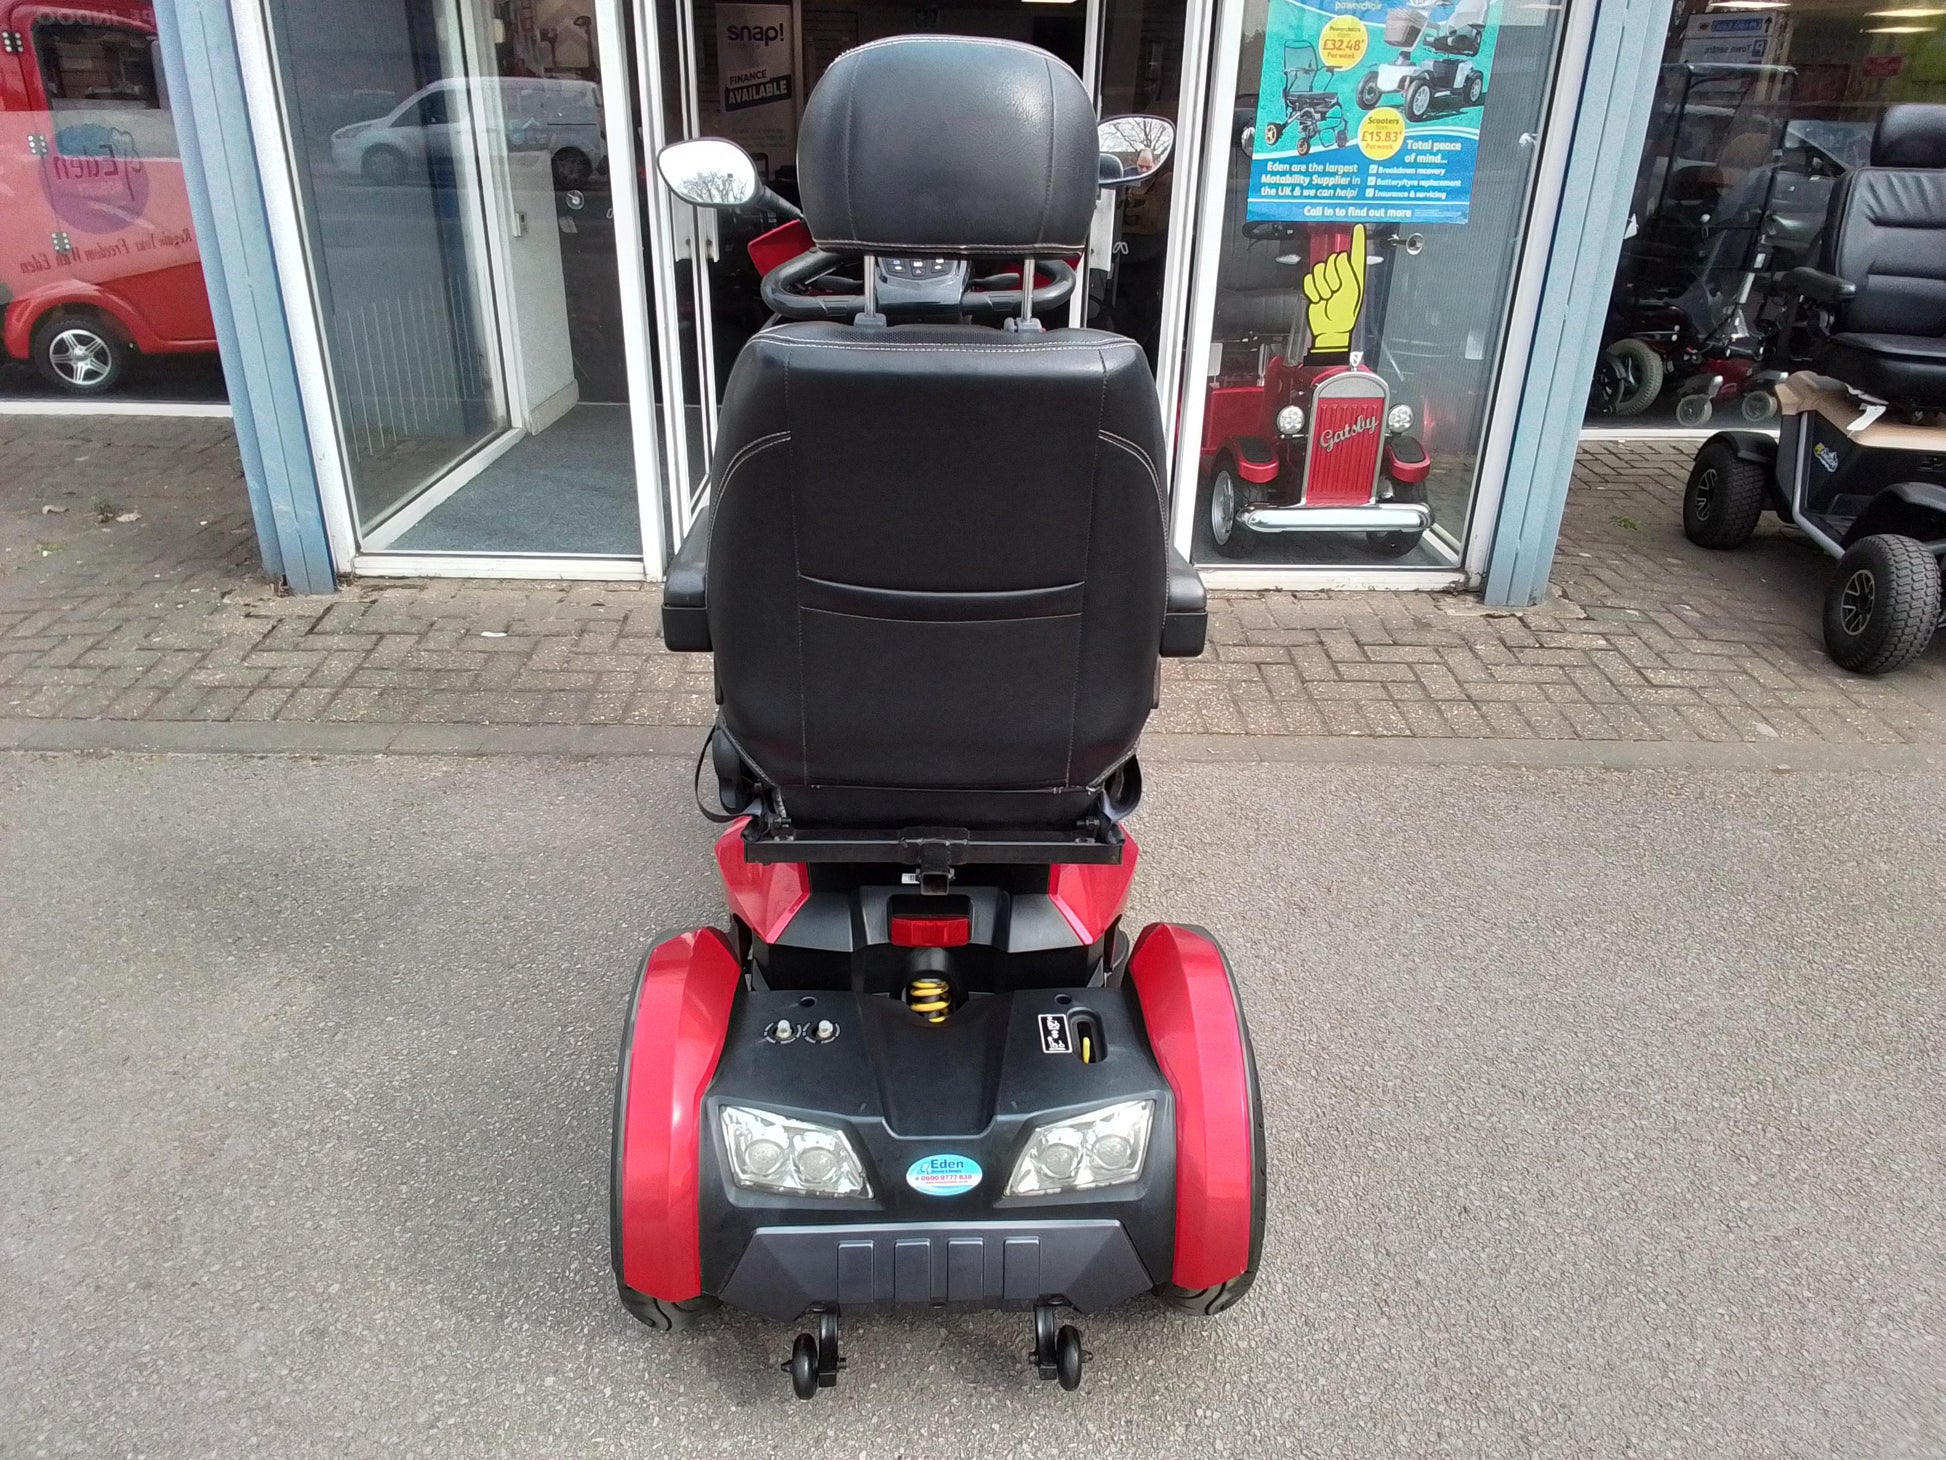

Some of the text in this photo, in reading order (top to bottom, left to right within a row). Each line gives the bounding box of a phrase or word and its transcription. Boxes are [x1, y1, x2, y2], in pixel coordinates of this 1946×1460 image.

[727, 23, 784, 46] snap!
[729, 69, 767, 86] FINANCE
[728, 80, 787, 104] AVAILABLE
[1367, 116, 1399, 125] Scooters
[1406, 139, 1462, 152] Total peace
[1404, 152, 1416, 163] of
[1267, 161, 1358, 174] Eden are the largest
[1378, 166, 1446, 176] Breakdown recovery
[1261, 174, 1311, 186] Motability
[1312, 175, 1351, 187] Supplier
[1419, 179, 1462, 188] replacement
[1261, 186, 1359, 199] the UK & we can help!
[1374, 190, 1408, 198] Insurance
[1415, 191, 1447, 200] servicing
[1304, 205, 1323, 216] Call
[1324, 208, 1334, 216] in
[1335, 208, 1346, 217] to
[1348, 207, 1367, 217] find
[1368, 208, 1386, 218] out
[1387, 209, 1413, 218] more
[1320, 415, 1380, 452] Gatsby
[930, 1159, 964, 1169] Eden
